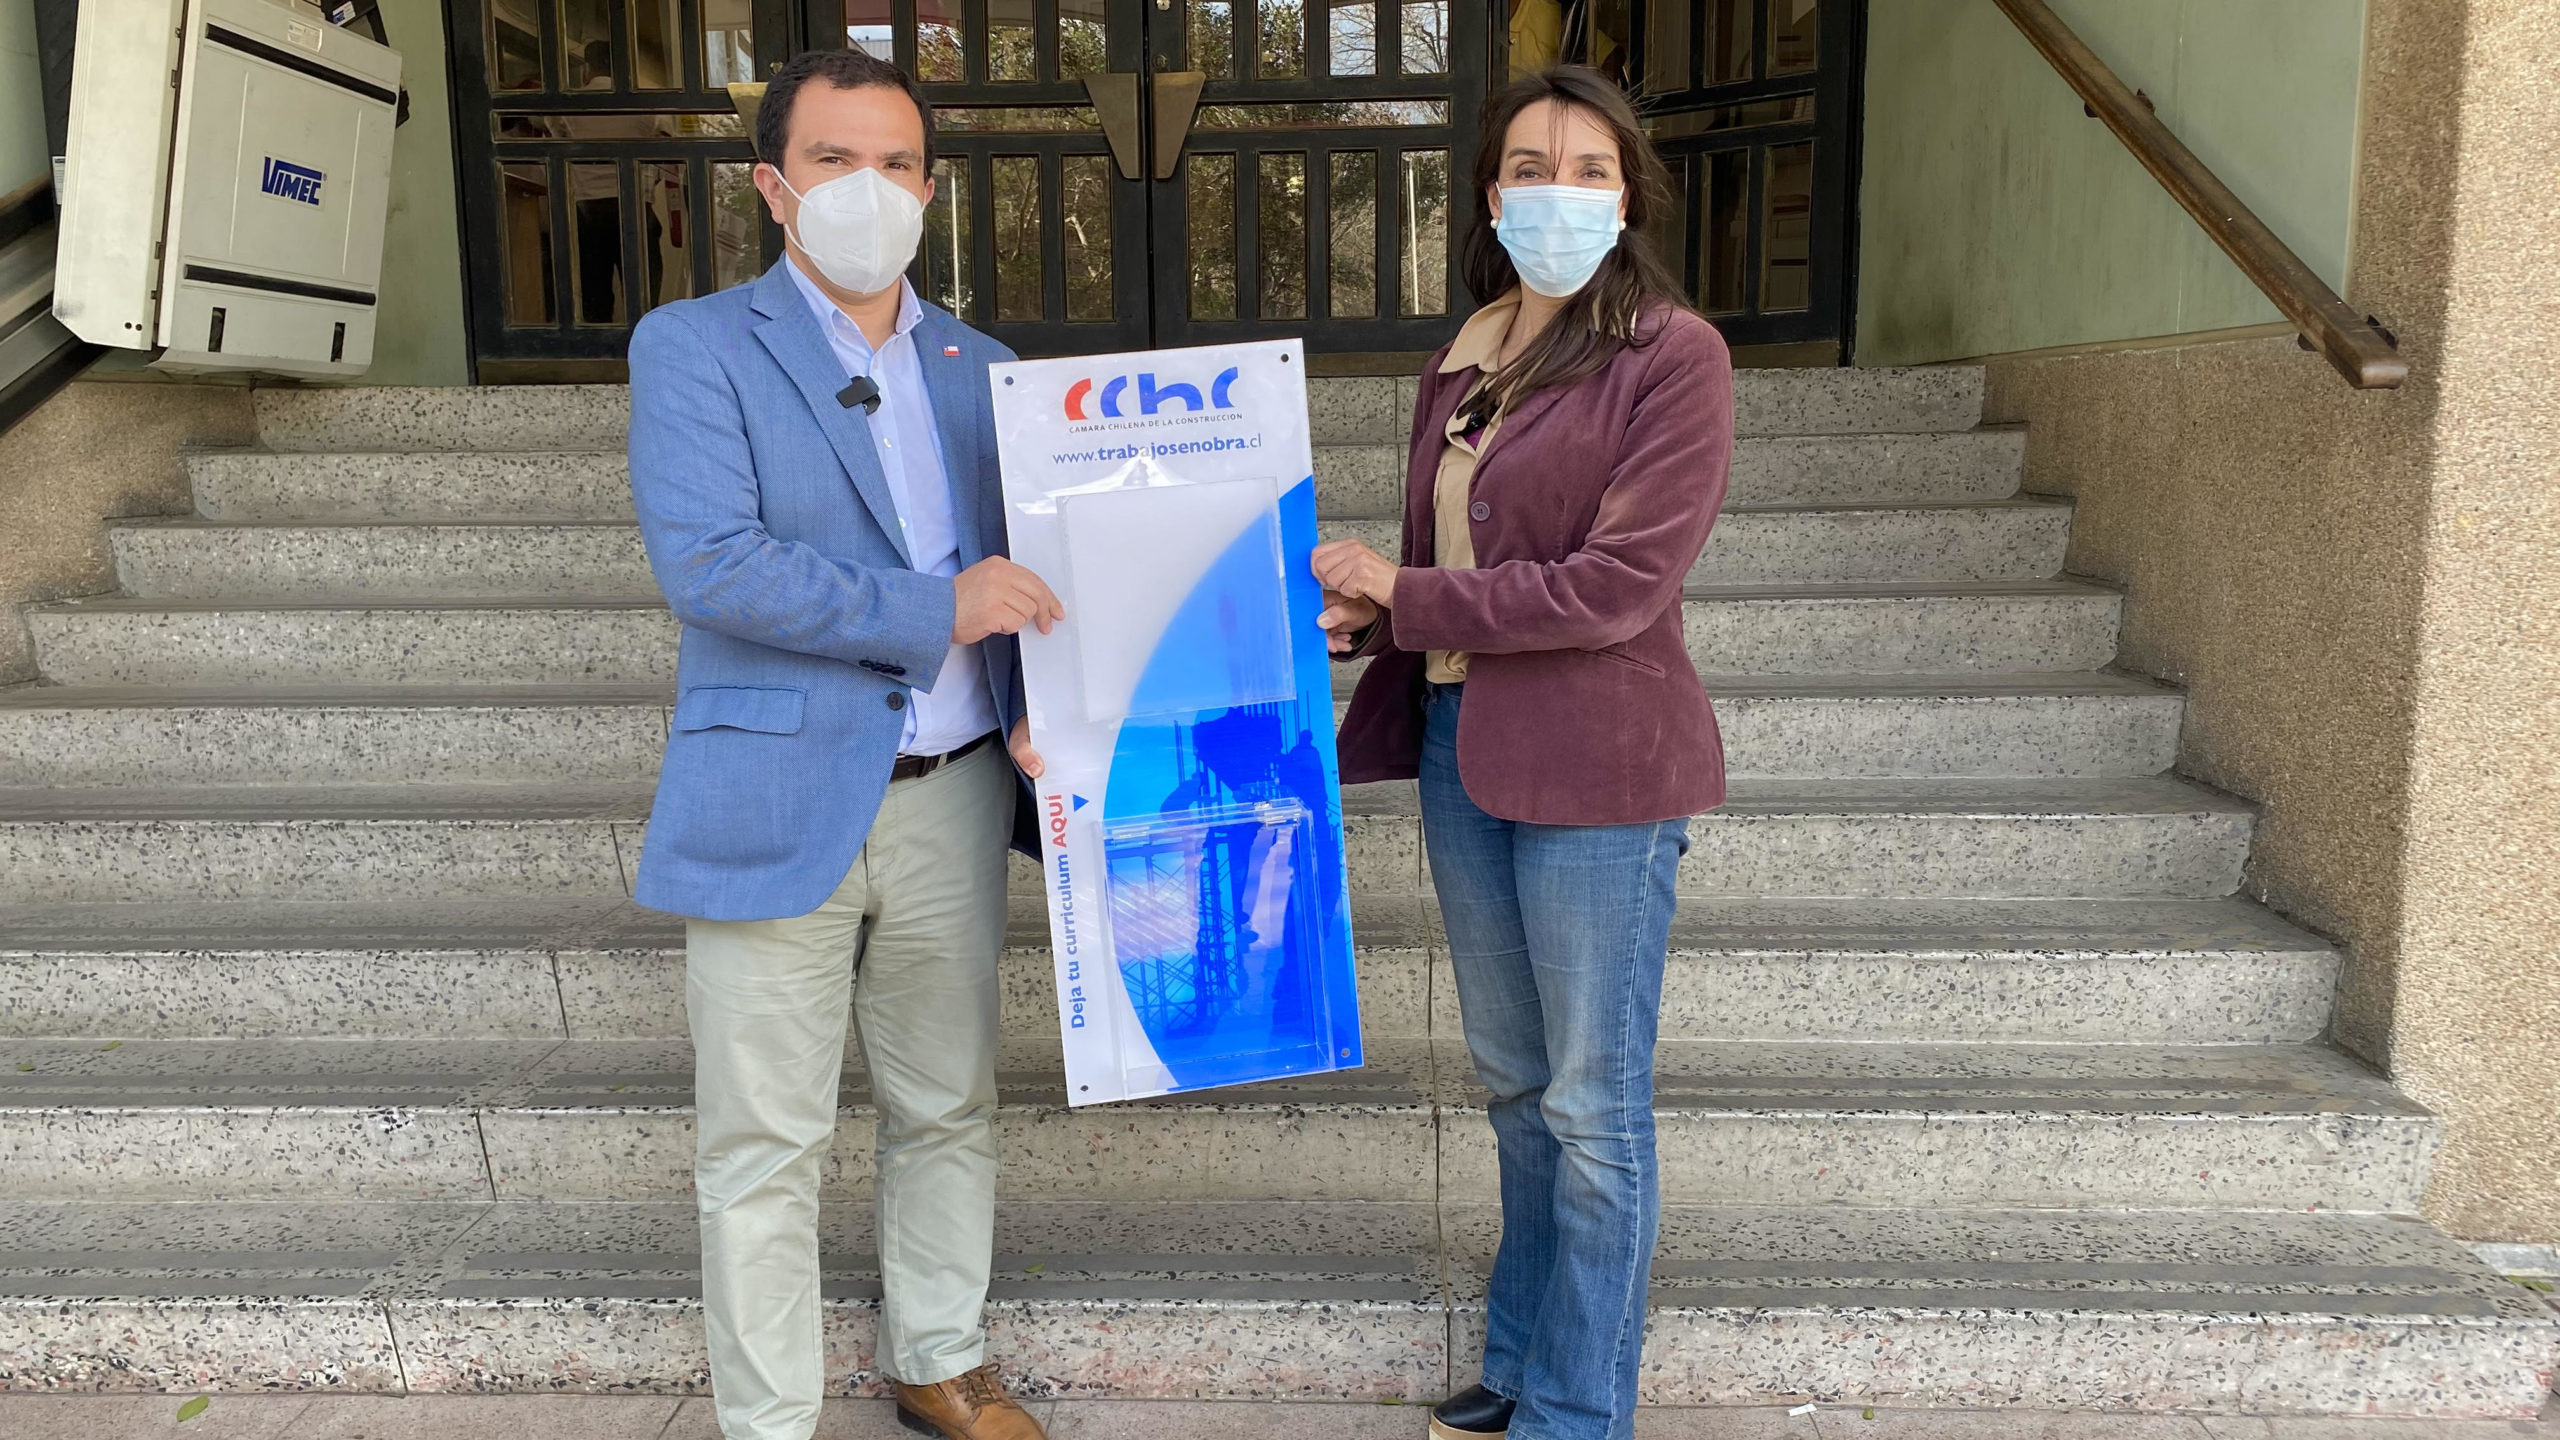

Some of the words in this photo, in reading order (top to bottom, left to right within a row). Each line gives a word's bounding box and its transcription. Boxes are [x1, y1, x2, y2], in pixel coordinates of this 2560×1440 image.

[262, 156, 322, 206] VIMEC
[1108, 422, 1145, 430] CHILENA
[1148, 419, 1160, 427] DE
[1162, 417, 1173, 426] LA
[1052, 432, 1262, 464] www.trabajosenobra.cl
[1044, 794, 1067, 848] AQUÍ
[1057, 854, 1078, 955] curriculum
[1067, 961, 1080, 981] tu
[1070, 986, 1087, 1029] Deja
